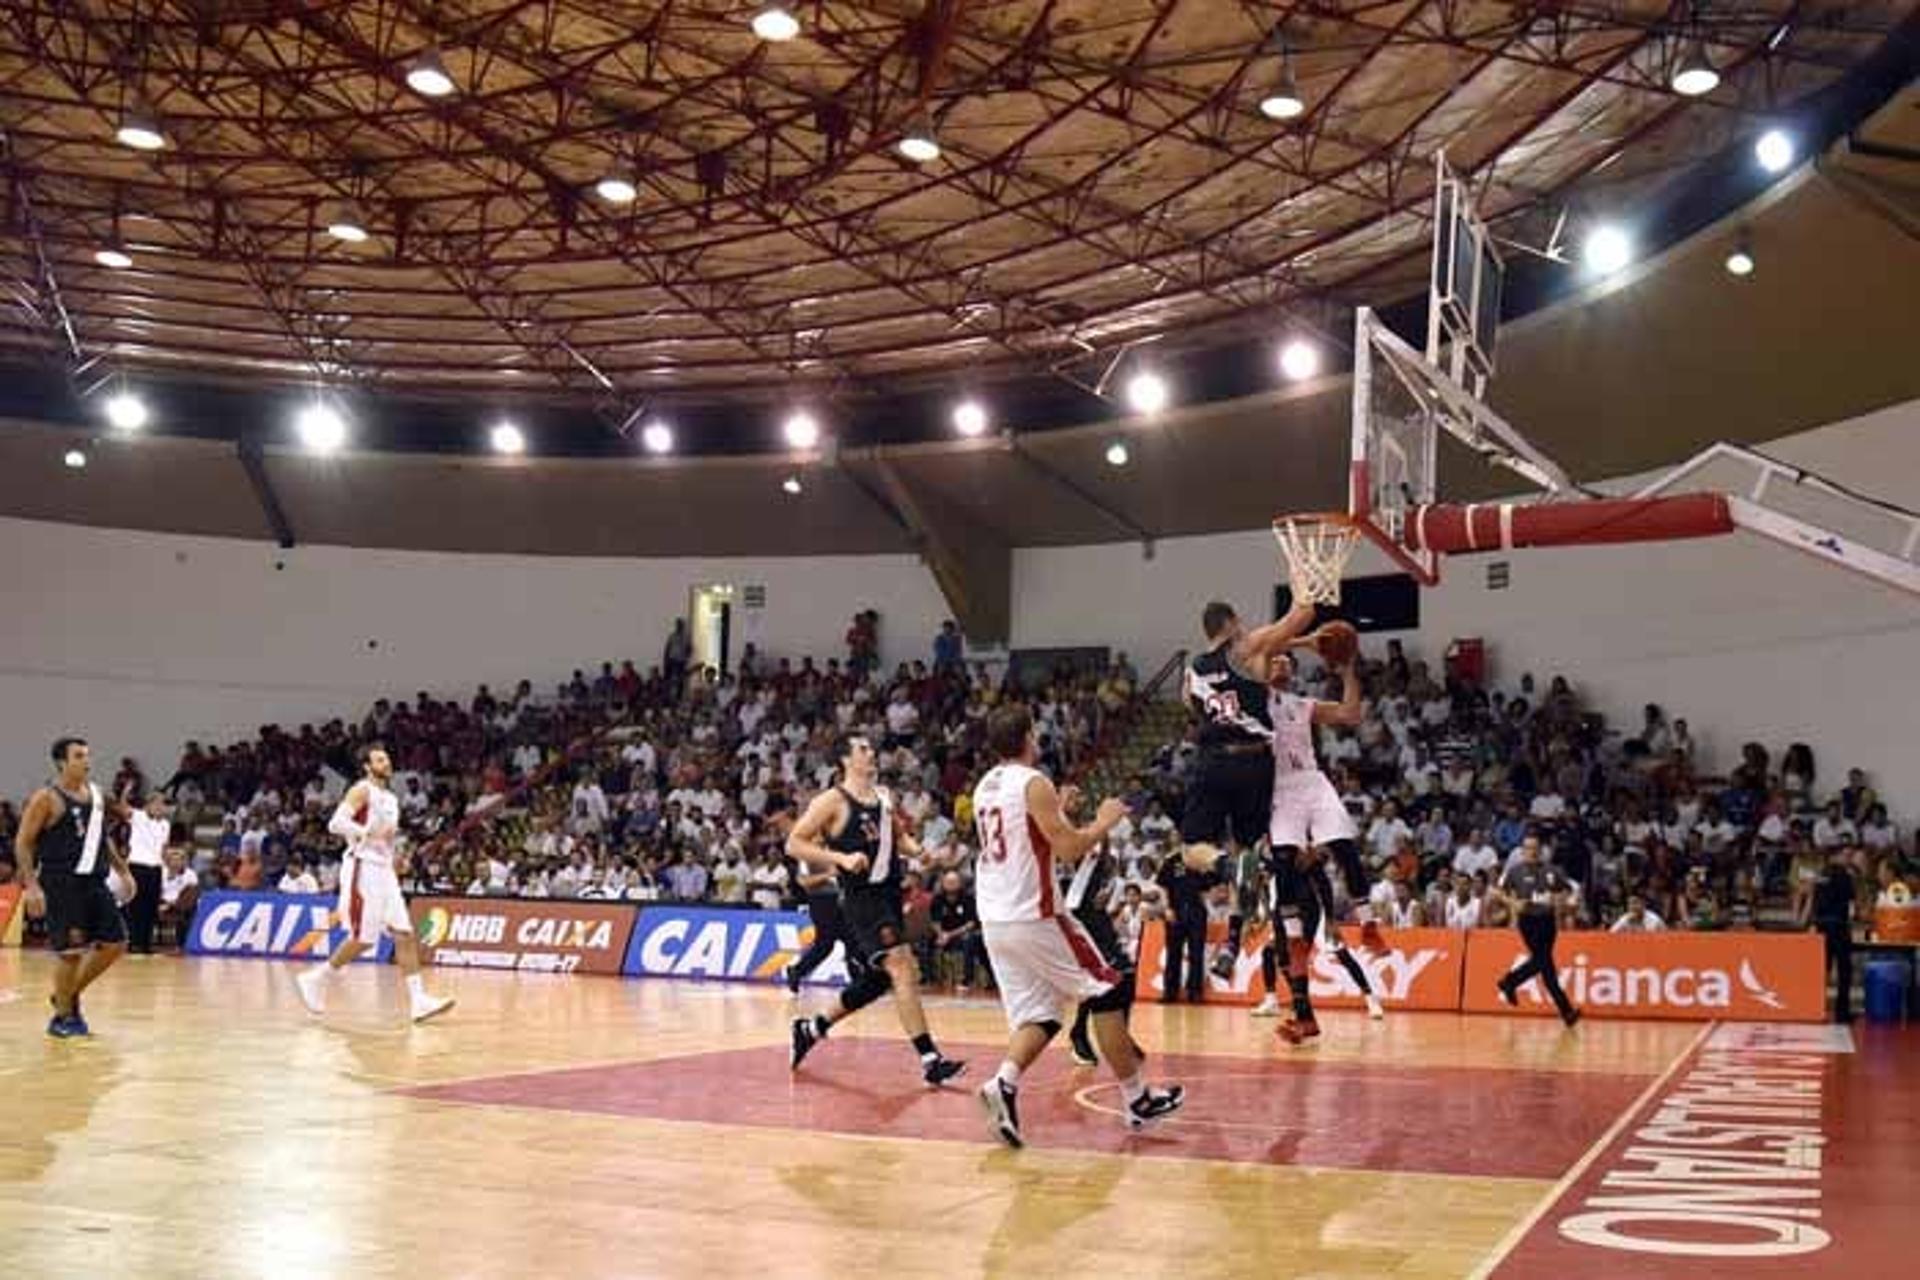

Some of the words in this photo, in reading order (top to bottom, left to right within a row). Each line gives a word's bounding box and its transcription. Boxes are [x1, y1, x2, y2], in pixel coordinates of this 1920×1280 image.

[200, 901, 378, 957] CAIX
[449, 913, 508, 943] NBB
[517, 917, 613, 949] CAIXA
